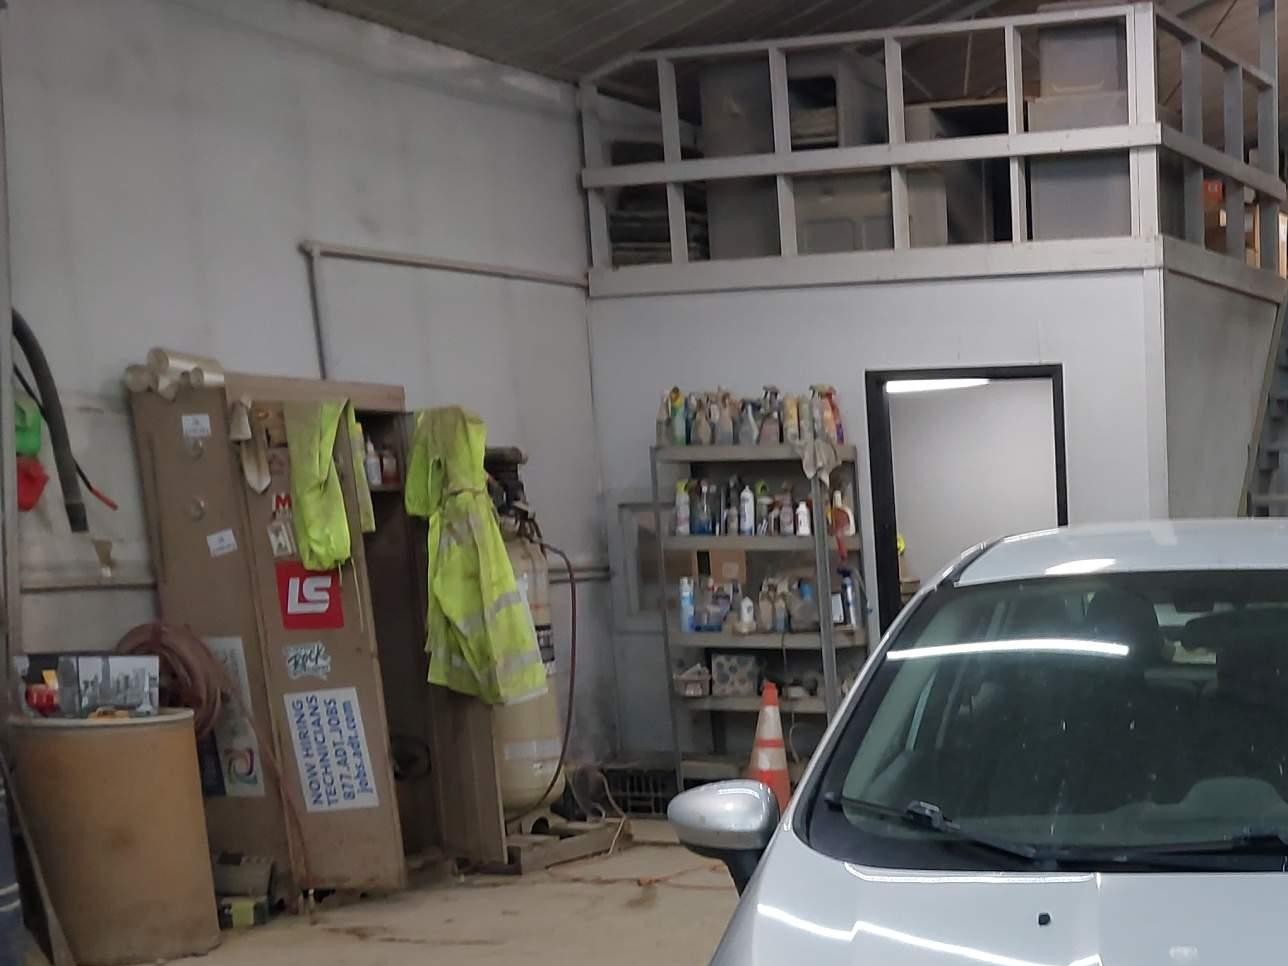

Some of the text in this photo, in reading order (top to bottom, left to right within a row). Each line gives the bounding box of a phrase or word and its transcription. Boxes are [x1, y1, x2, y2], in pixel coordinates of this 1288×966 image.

[291, 699, 315, 759] HIRING
[305, 694, 339, 806] TECHNICIANS
[304, 761, 325, 806] NOW
